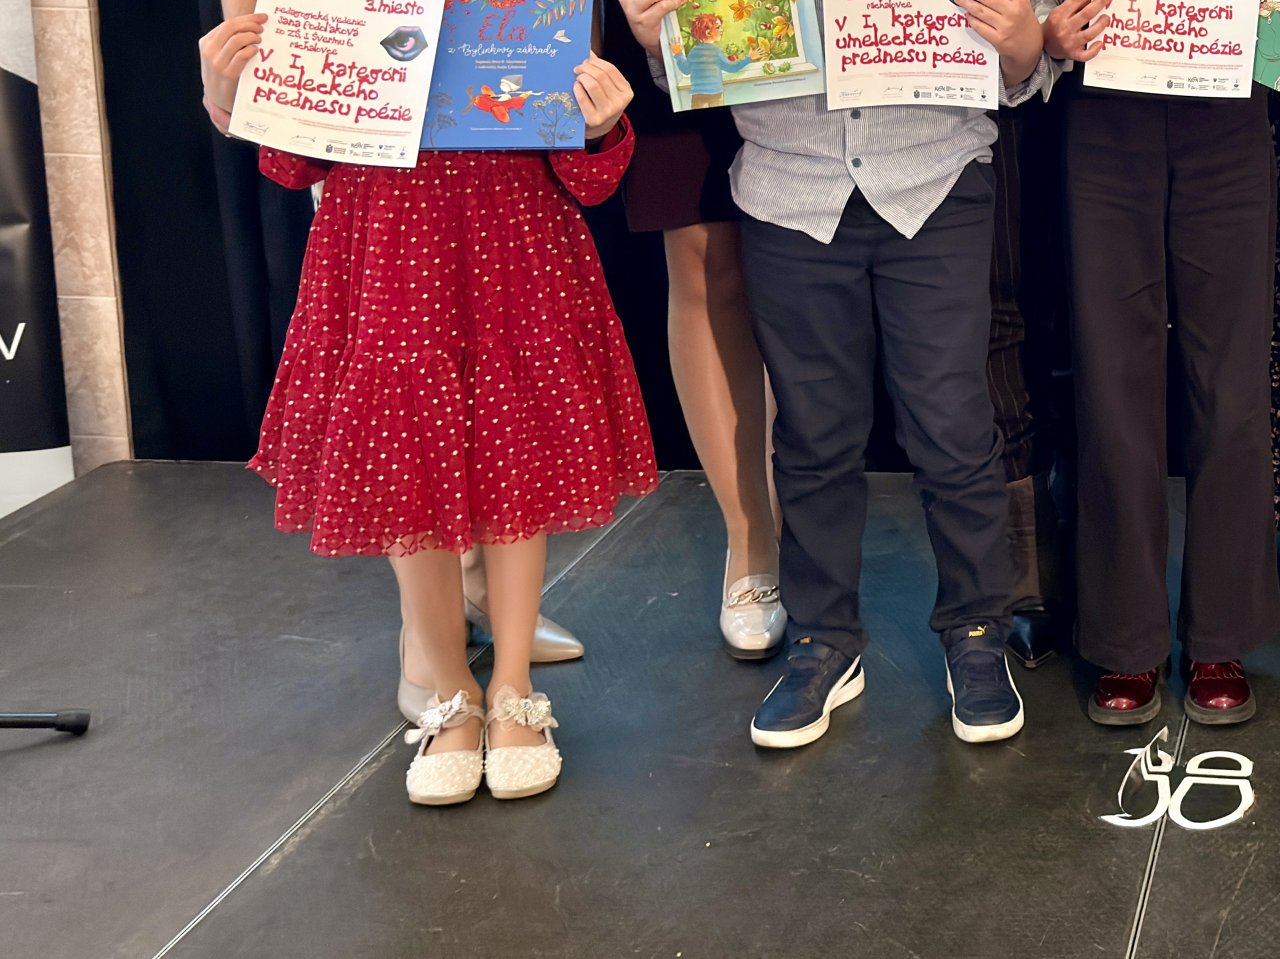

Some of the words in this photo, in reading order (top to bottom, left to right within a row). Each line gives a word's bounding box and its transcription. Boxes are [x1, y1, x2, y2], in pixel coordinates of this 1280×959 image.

[479, 10, 527, 43] Ela
[835, 16, 848, 32] V
[891, 7, 971, 31] kategóri
[1106, 13, 1208, 38] meleckého
[836, 23, 949, 49] umeleckého
[1101, 33, 1185, 53] prednesu
[1188, 39, 1243, 59] poézie
[321, 54, 407, 85] kategórii
[841, 48, 927, 72] prednesu
[931, 47, 987, 69] poézie
[253, 65, 379, 101] umeleckého
[253, 85, 351, 116] prednesu
[354, 102, 413, 124] poézie
